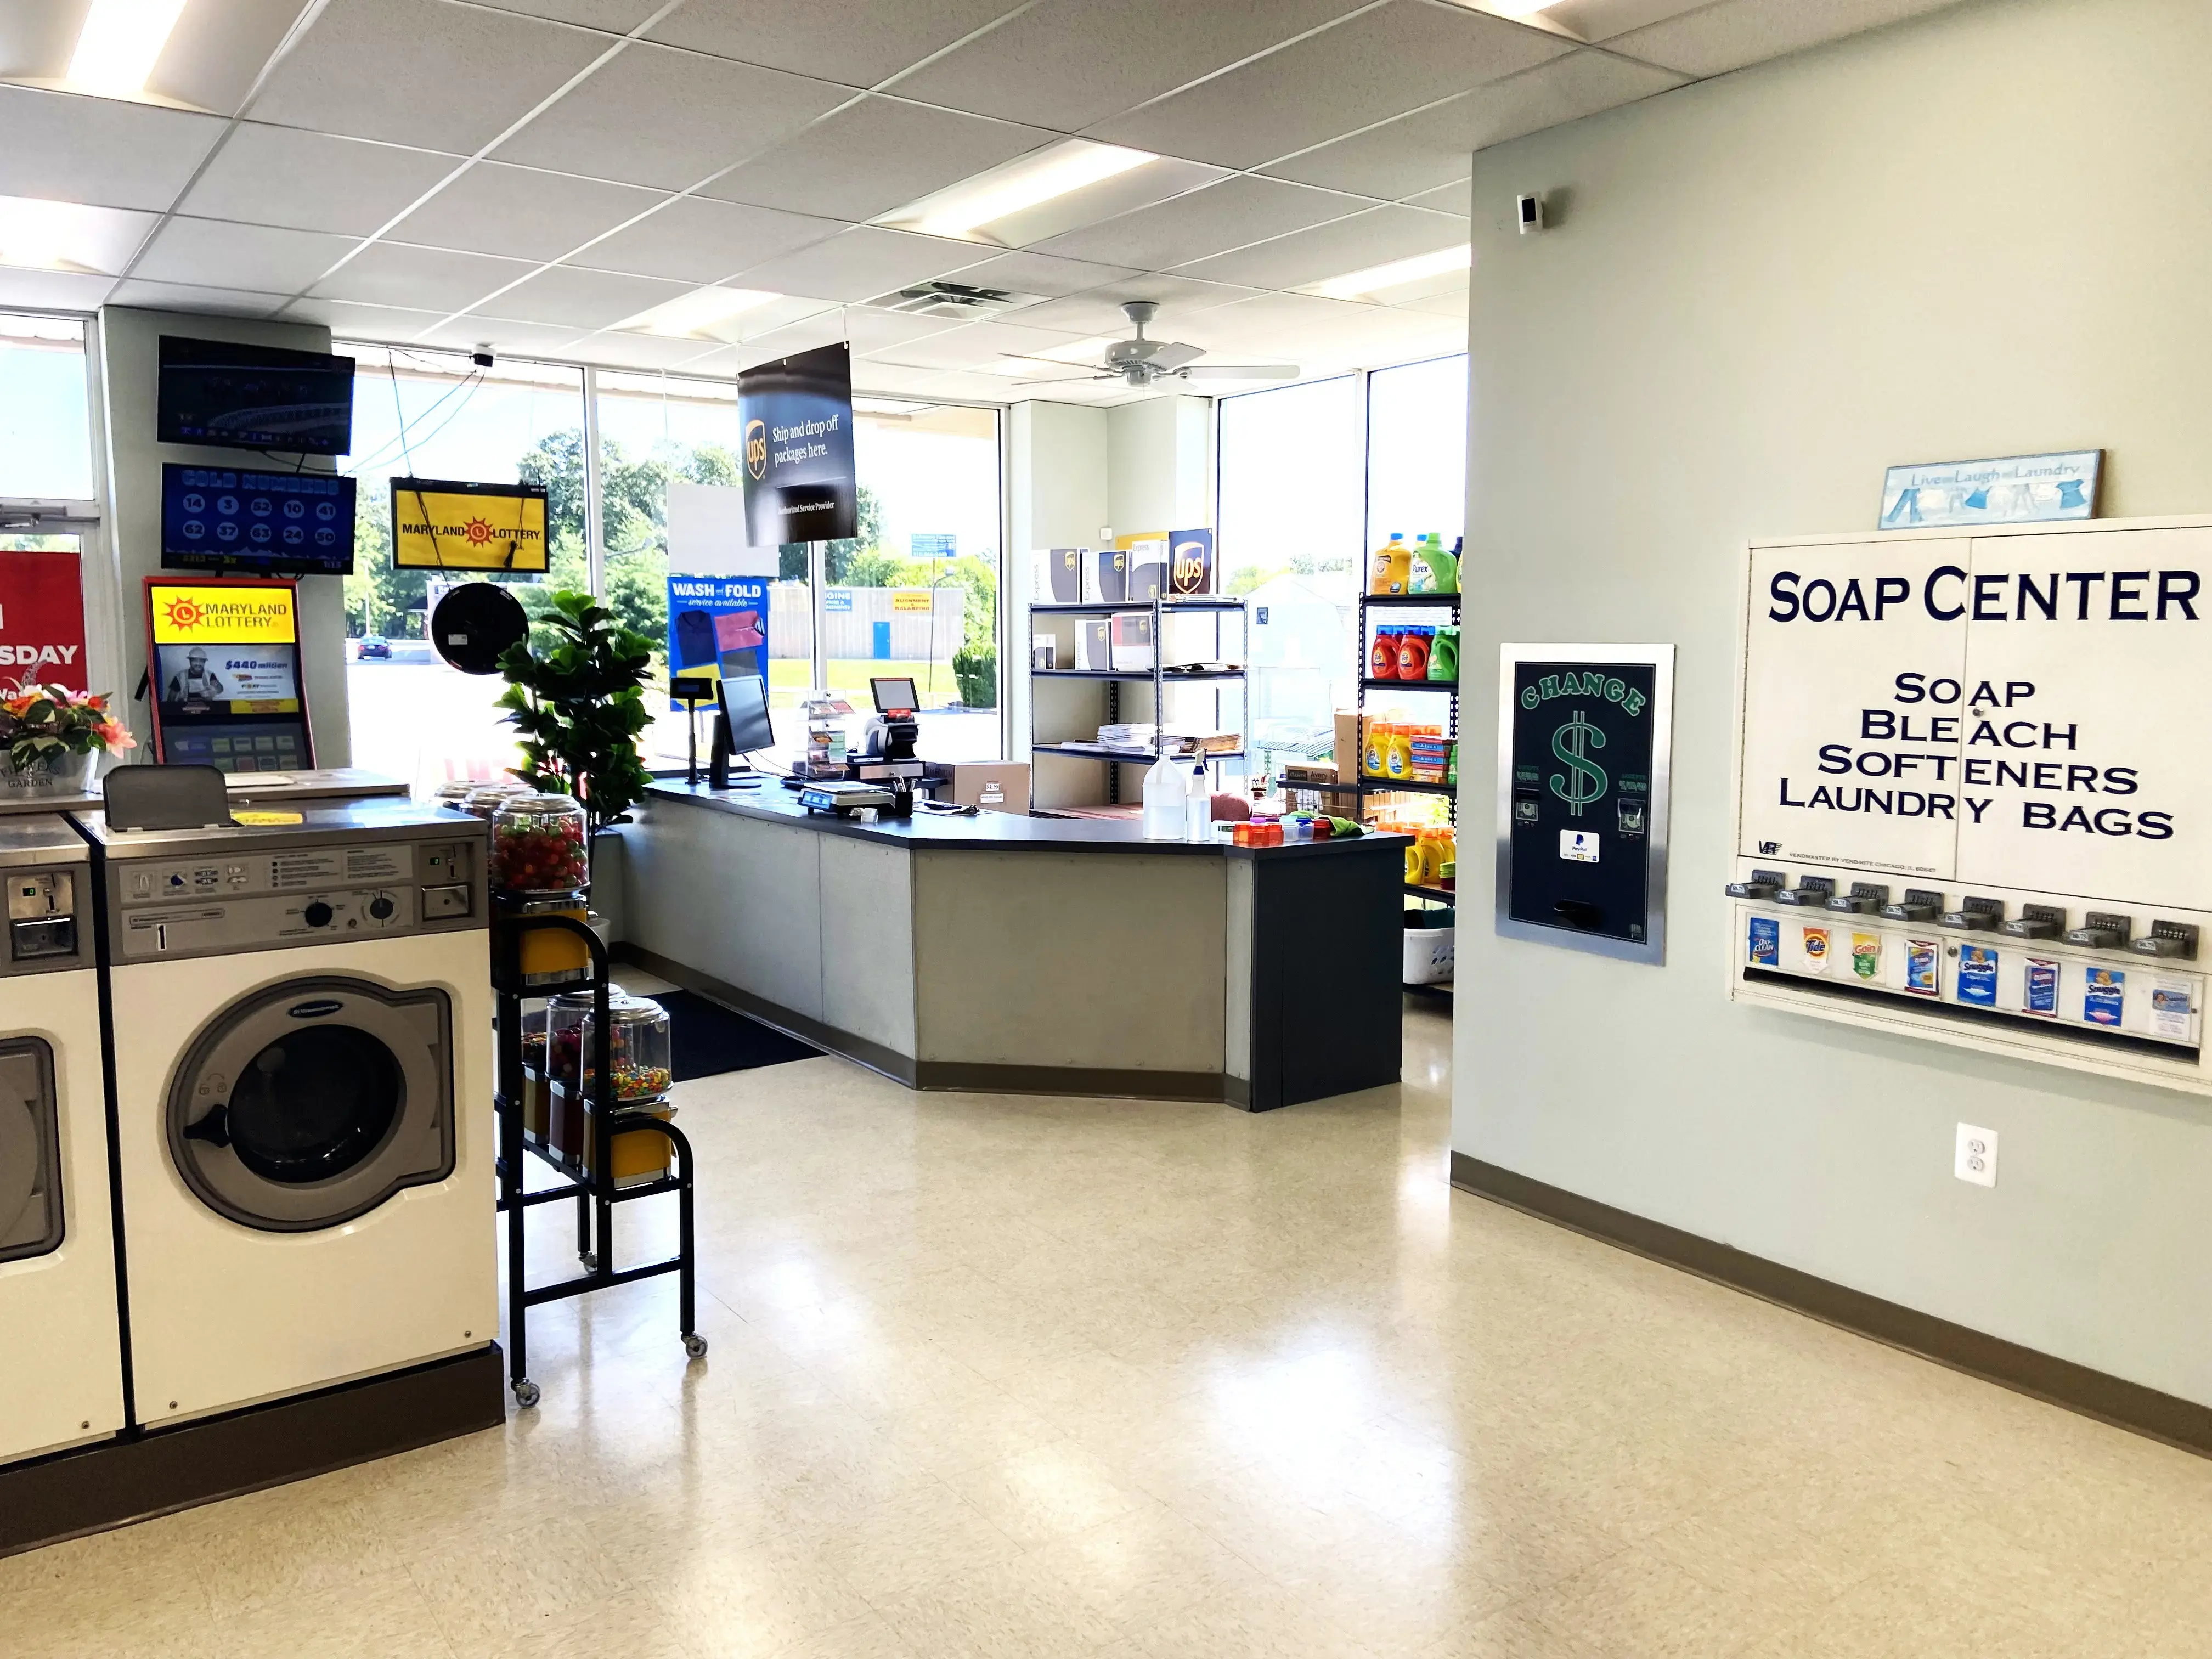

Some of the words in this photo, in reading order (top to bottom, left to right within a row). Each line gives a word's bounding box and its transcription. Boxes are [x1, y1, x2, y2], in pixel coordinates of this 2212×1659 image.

[772, 428, 788, 444] Ship
[790, 421, 805, 439] and
[805, 420, 825, 437] drop
[826, 414, 839, 431] off
[748, 438, 765, 471] ups
[774, 447, 807, 468] packages
[808, 442, 828, 458] here.
[1911, 473, 1941, 487] Live
[1955, 469, 1999, 484] Laugh
[2015, 464, 2081, 479] Laundry
[185, 498, 202, 508] 14
[224, 499, 233, 510] 3
[253, 502, 270, 512] 52
[286, 504, 301, 514] 10
[318, 506, 334, 516] 41
[778, 504, 800, 515] Authorized
[800, 501, 815, 512] Service
[815, 500, 834, 511] Provider
[185, 526, 204, 534] 62
[219, 527, 236, 536] 37
[284, 530, 302, 539] 24
[316, 532, 334, 541] 50
[402, 523, 465, 536] MARYLAND
[493, 529, 540, 540] LOTTERY
[1133, 544, 1149, 552] Express
[1065, 557, 1075, 568] ups
[1115, 557, 1124, 568] ups
[1412, 564, 1427, 573] Purex
[1176, 557, 1201, 586] ups
[672, 583, 714, 596] WASH
[725, 584, 761, 597] FOLD
[1768, 571, 1911, 623] SOAP
[1923, 565, 2202, 622] CENTER
[206, 603, 286, 615] MARYLAND
[714, 599, 748, 607] available
[206, 617, 272, 628] LOTTERY
[0, 645, 78, 664] SDAY
[225, 659, 257, 669] $440
[1521, 673, 1646, 716] CHANGE
[1894, 672, 2036, 708] SOAP
[1861, 709, 2078, 751] BLEACH
[1311, 771, 1327, 780] Avery
[1818, 744, 2139, 795] SOFTENERS
[8, 779, 52, 788] GARDEN
[1779, 777, 1994, 825] LAUNDRY
[2022, 802, 2175, 841] BAGS
[1790, 853, 1830, 861] VENDMASTER
[159, 924, 165, 949] 1
[1806, 939, 1825, 953] Tide
[1855, 944, 1875, 955] Gain
[1964, 962, 1994, 973] Snuggle
[2088, 984, 2121, 995] Snuggle
